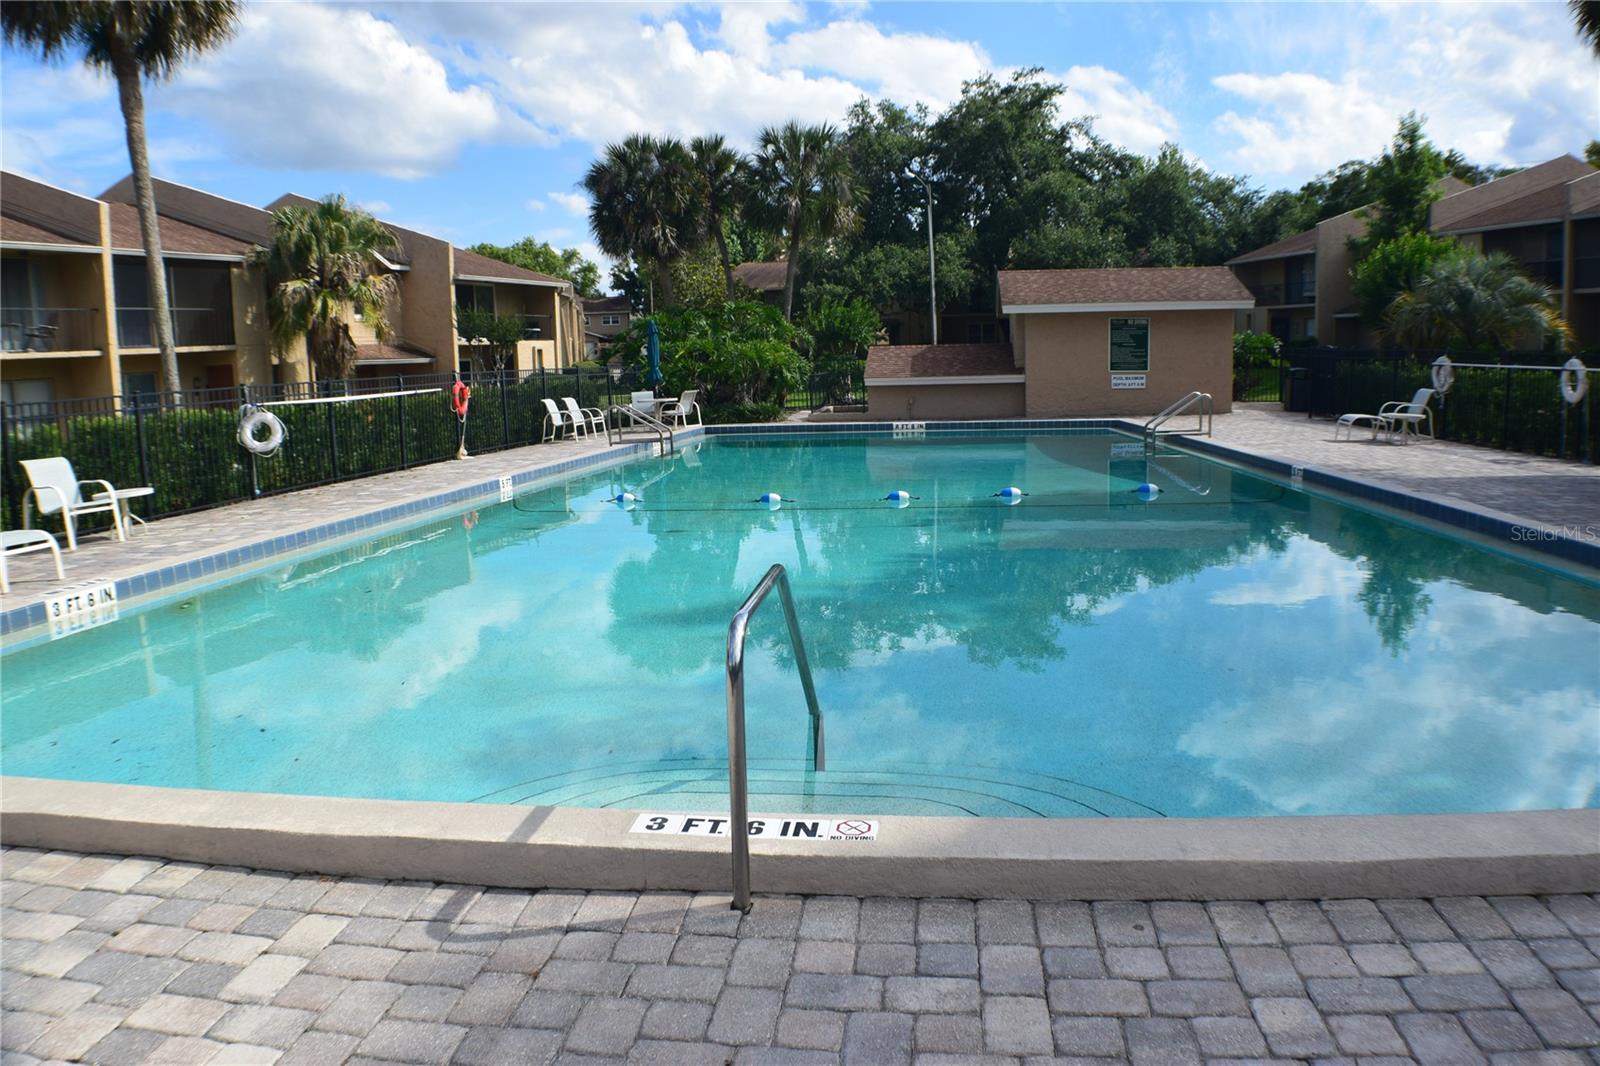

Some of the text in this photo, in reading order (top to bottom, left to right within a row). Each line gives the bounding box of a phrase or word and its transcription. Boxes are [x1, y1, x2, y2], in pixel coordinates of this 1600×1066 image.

[52, 602, 61, 617] 3
[87, 592, 96, 608] 6
[645, 816, 824, 838] 3 FT. 6 IN.
